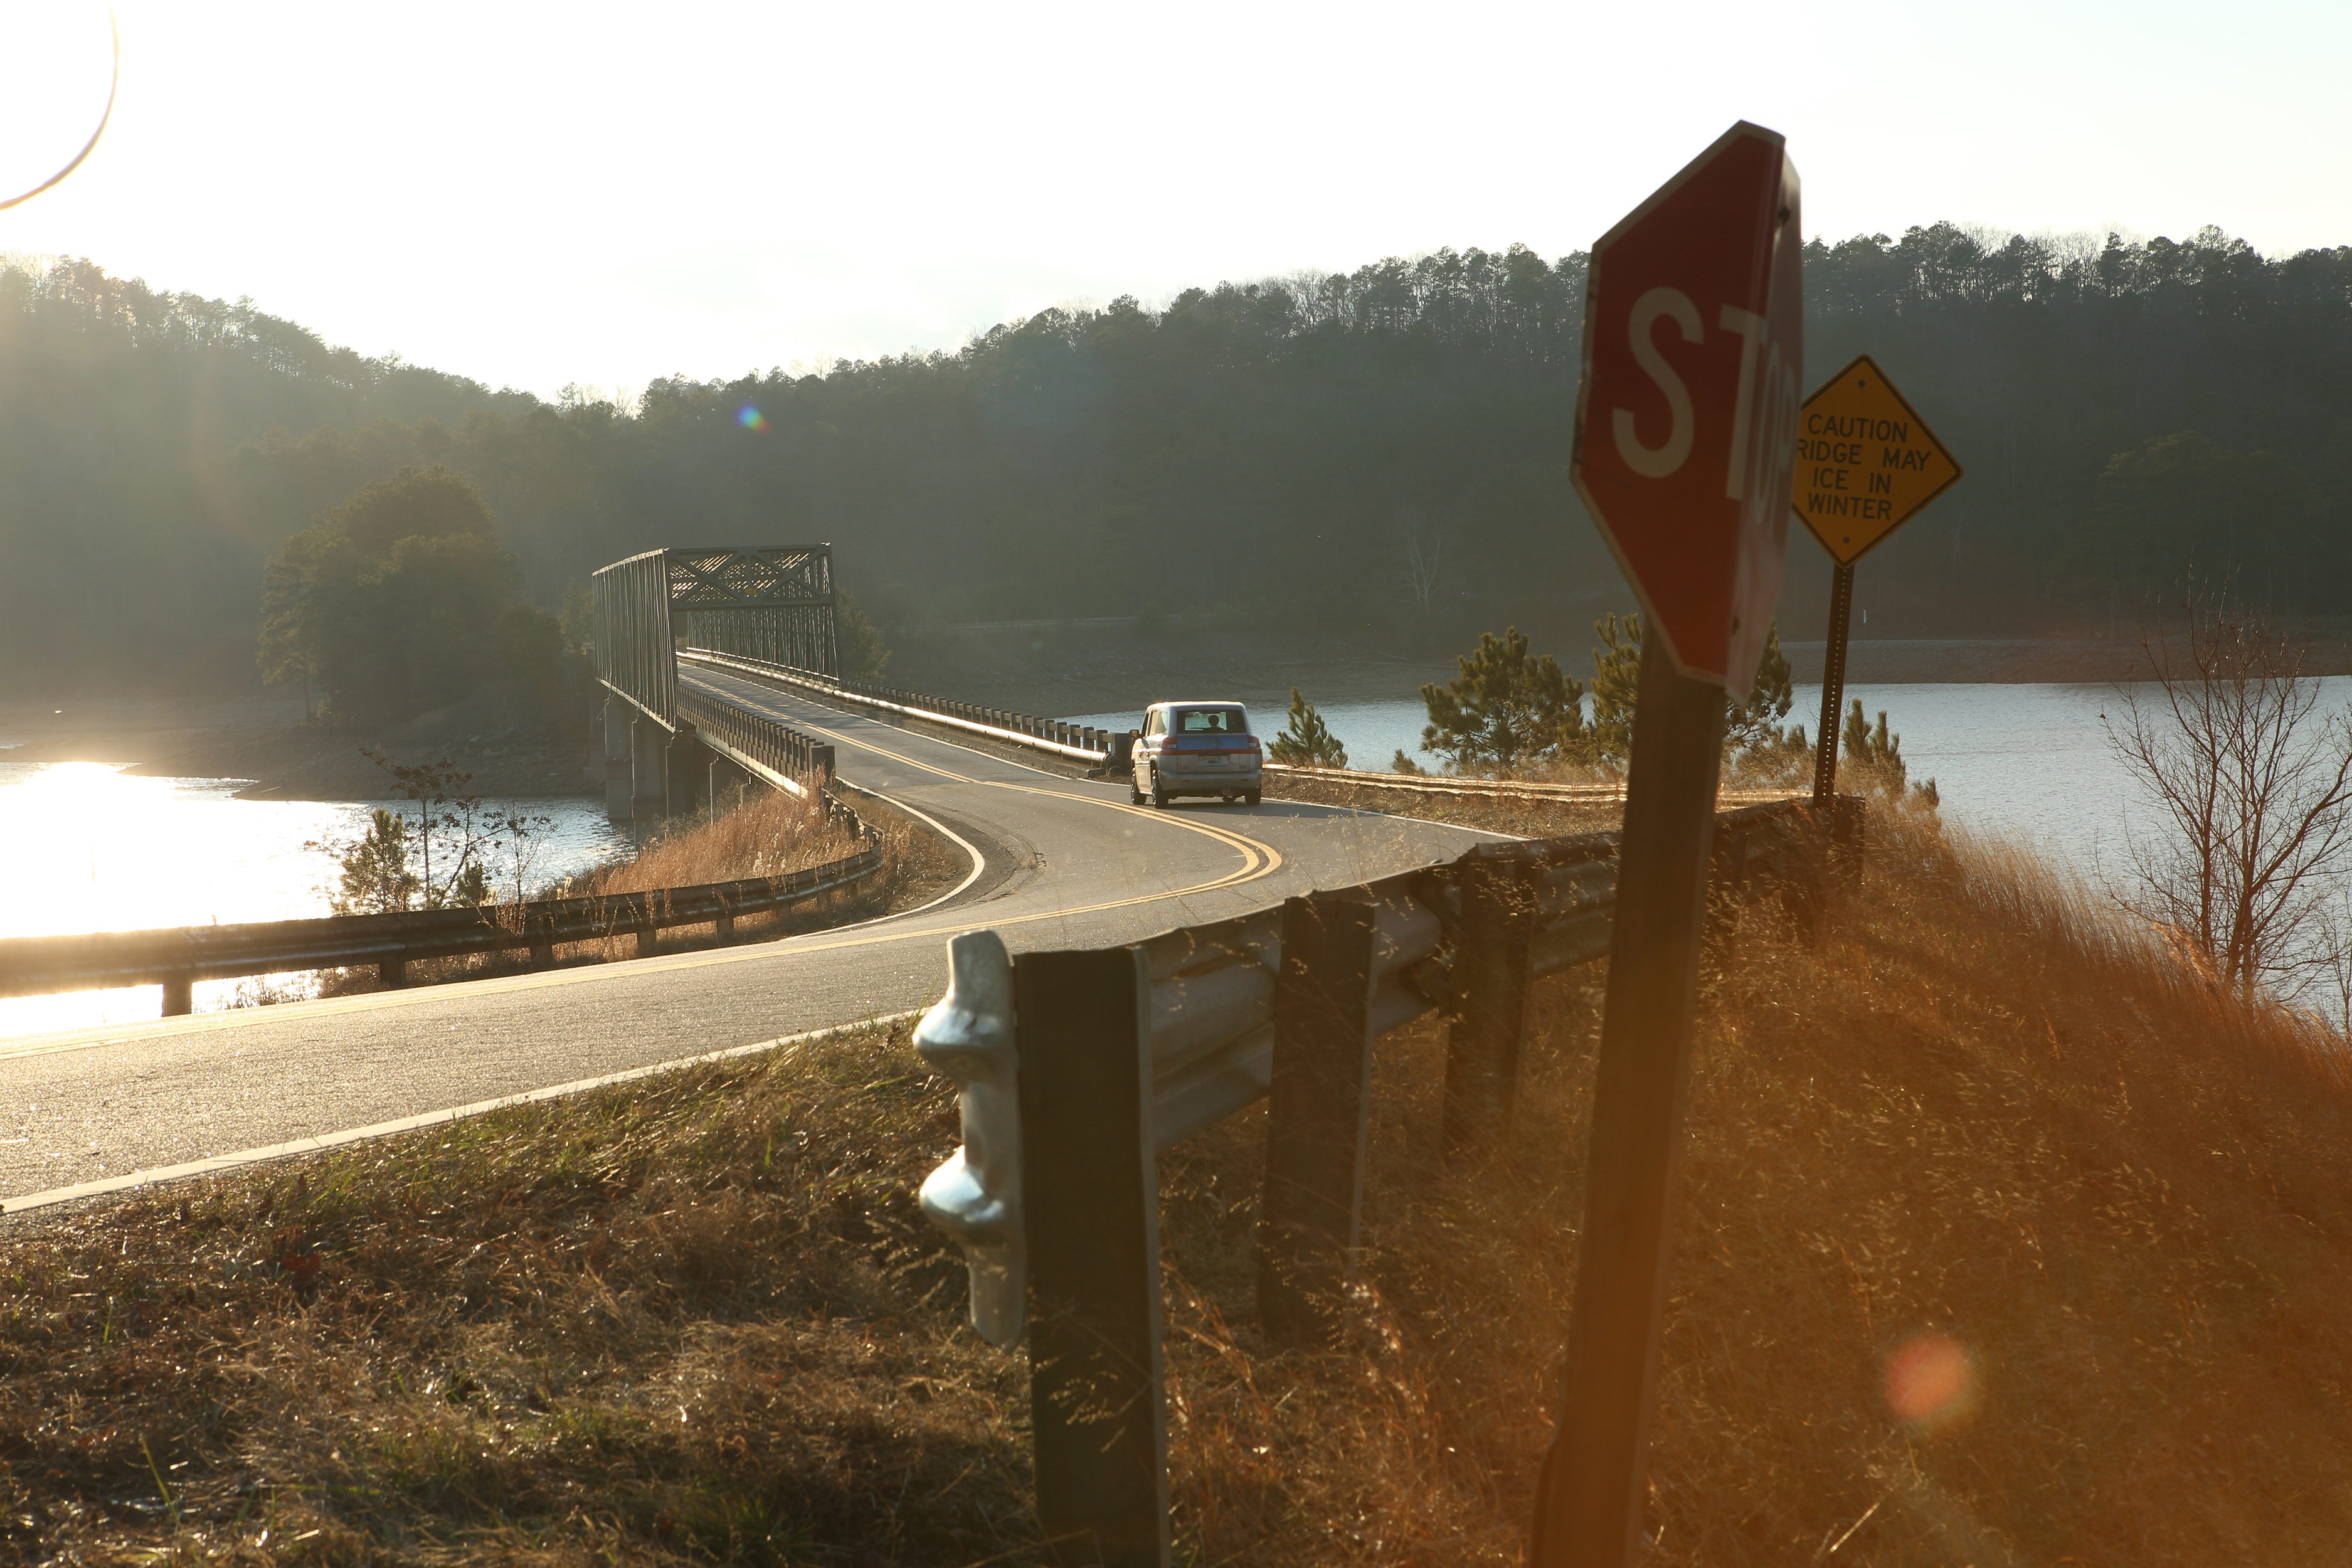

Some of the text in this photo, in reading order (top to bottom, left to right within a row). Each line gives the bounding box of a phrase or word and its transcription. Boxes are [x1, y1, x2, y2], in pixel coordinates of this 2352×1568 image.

[1612, 286, 1796, 541] STOP
[1807, 413, 1909, 443] CAUTION
[1797, 439, 1932, 472] RIDGE MAY
[1813, 466, 1892, 495] ICE IN
[1808, 492, 1893, 521] WINTER
